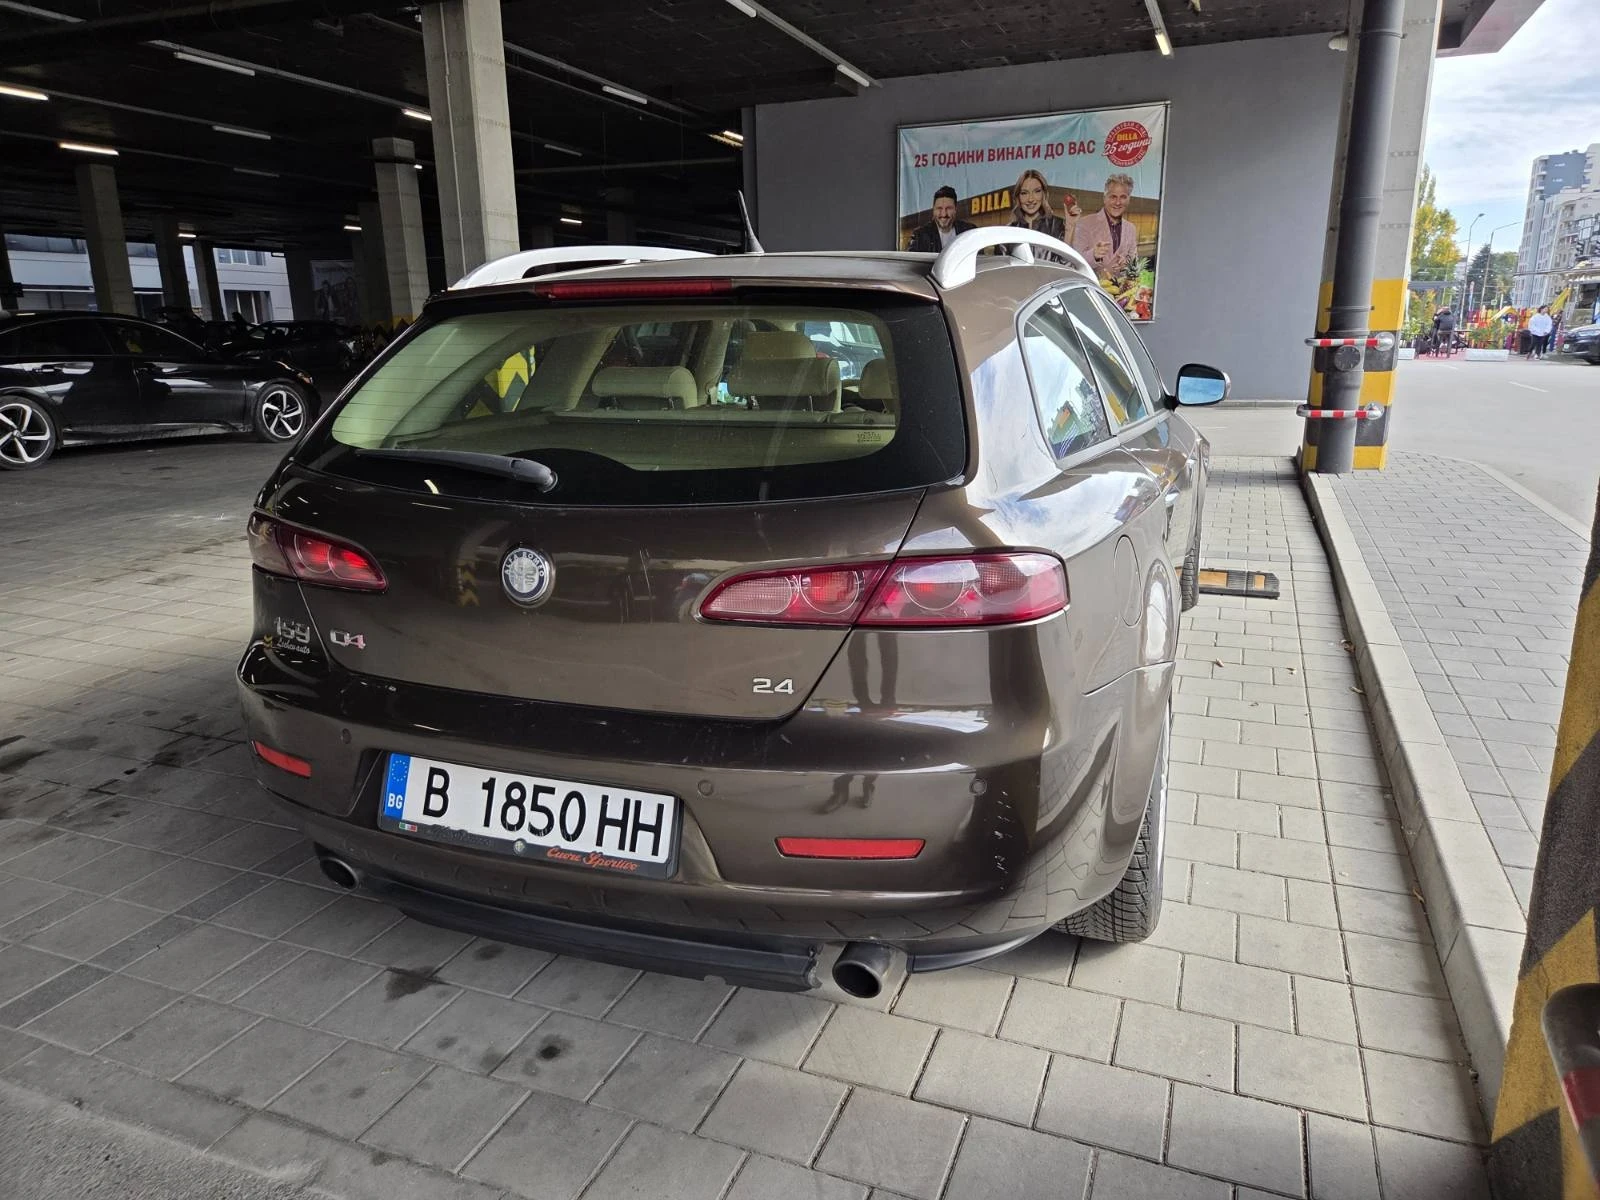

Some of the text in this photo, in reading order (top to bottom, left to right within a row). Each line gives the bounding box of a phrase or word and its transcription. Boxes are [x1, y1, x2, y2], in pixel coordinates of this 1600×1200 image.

[914, 140, 1096, 168] 25 ГОДИНИ ВИНАГИ ДО ВАС
[1101, 137, 1152, 156] 25 години
[971, 190, 1011, 215] BILLA
[504, 552, 545, 577] ALFA ROMEO
[274, 617, 310, 644] 159
[330, 629, 366, 650] Q4
[387, 793, 403, 809] BG
[423, 766, 451, 819] B
[481, 777, 587, 843] 1850
[595, 795, 665, 857] HH
[546, 847, 639, 871] Cuore Sportivo
